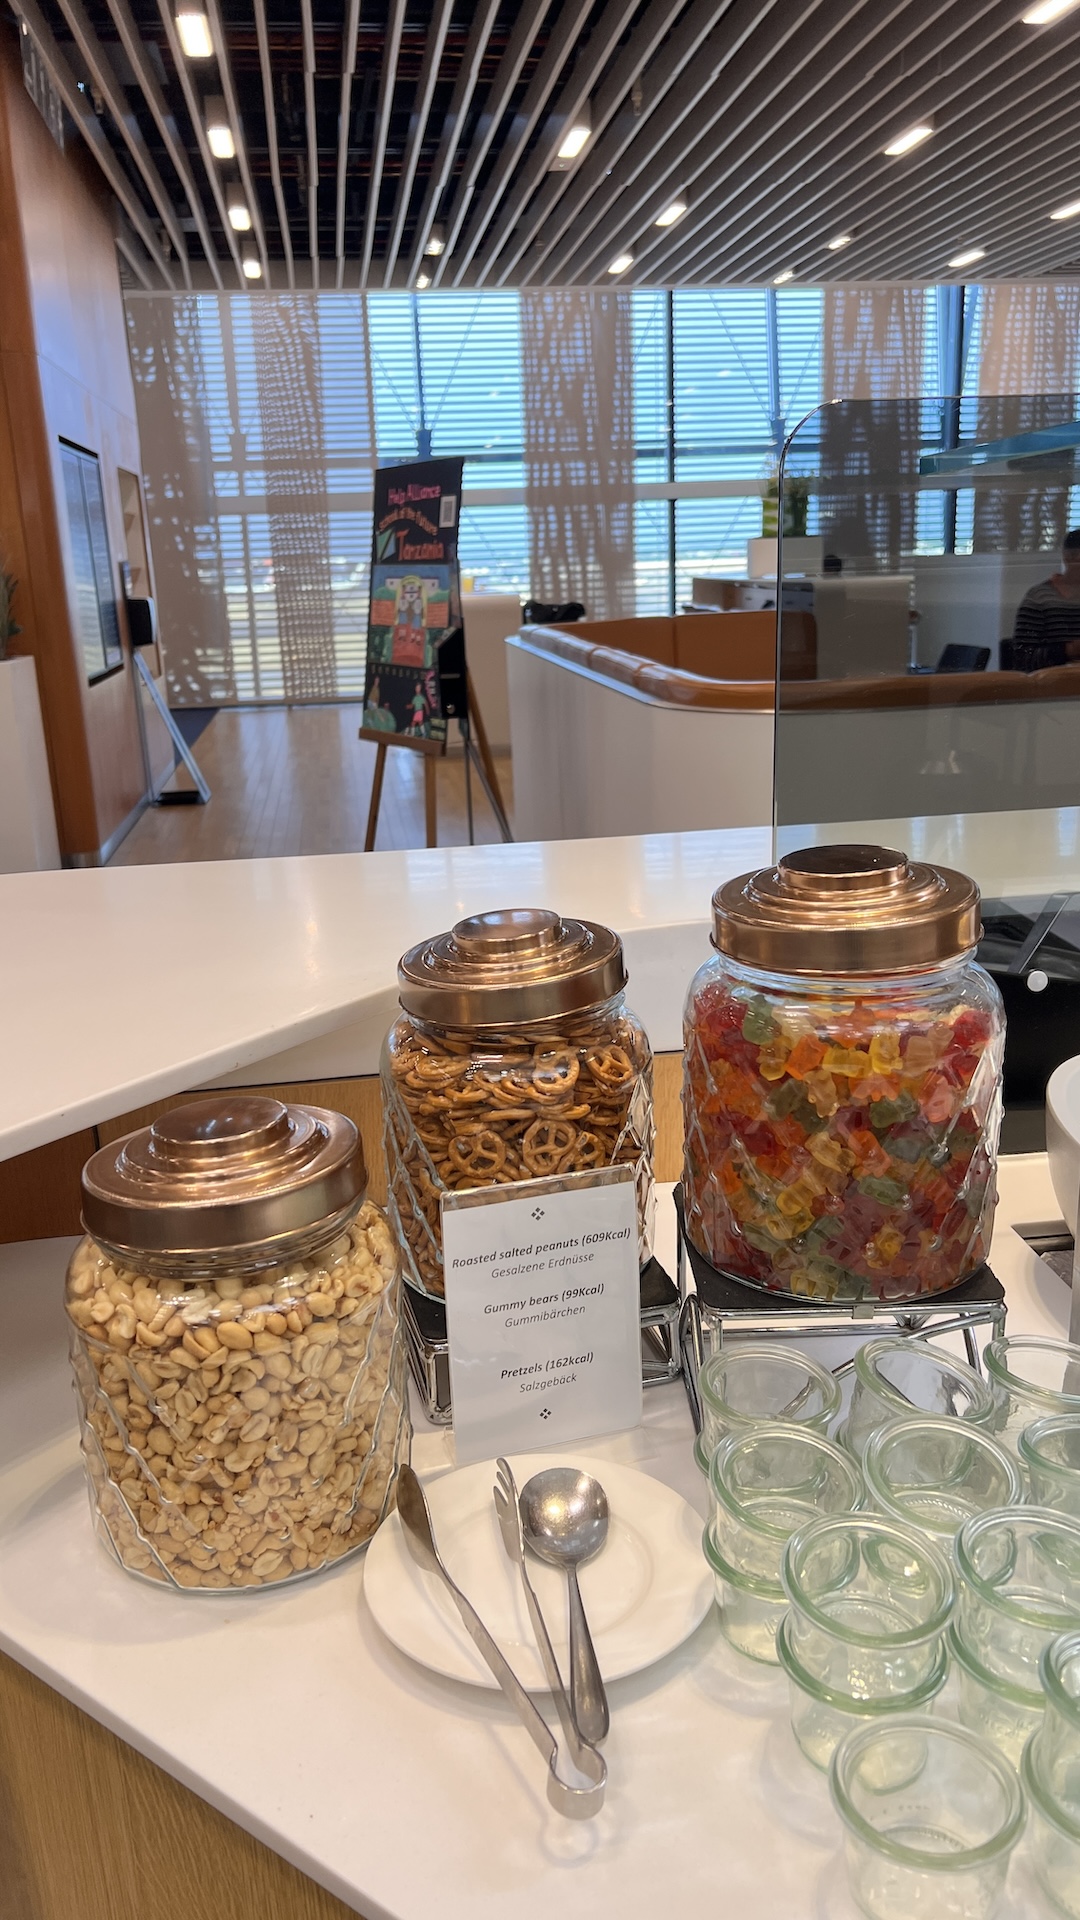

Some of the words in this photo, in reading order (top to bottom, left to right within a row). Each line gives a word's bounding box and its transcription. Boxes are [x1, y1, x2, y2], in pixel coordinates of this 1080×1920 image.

[452, 1251, 497, 1269] Roasted
[499, 1244, 533, 1260] salted
[535, 1238, 579, 1256] peanuts
[581, 1227, 631, 1247] (609Kcal)
[491, 1263, 545, 1279] Gesalzene
[548, 1252, 595, 1269] Erdnüsse
[484, 1300, 526, 1315] Gummy
[529, 1293, 559, 1307] bears
[561, 1283, 605, 1302] (99Kcal)
[504, 1305, 586, 1328] Gummibärchen
[501, 1362, 543, 1379] Pretzels
[545, 1351, 594, 1373] (162kcal)
[519, 1373, 577, 1393] Salzgebäck
